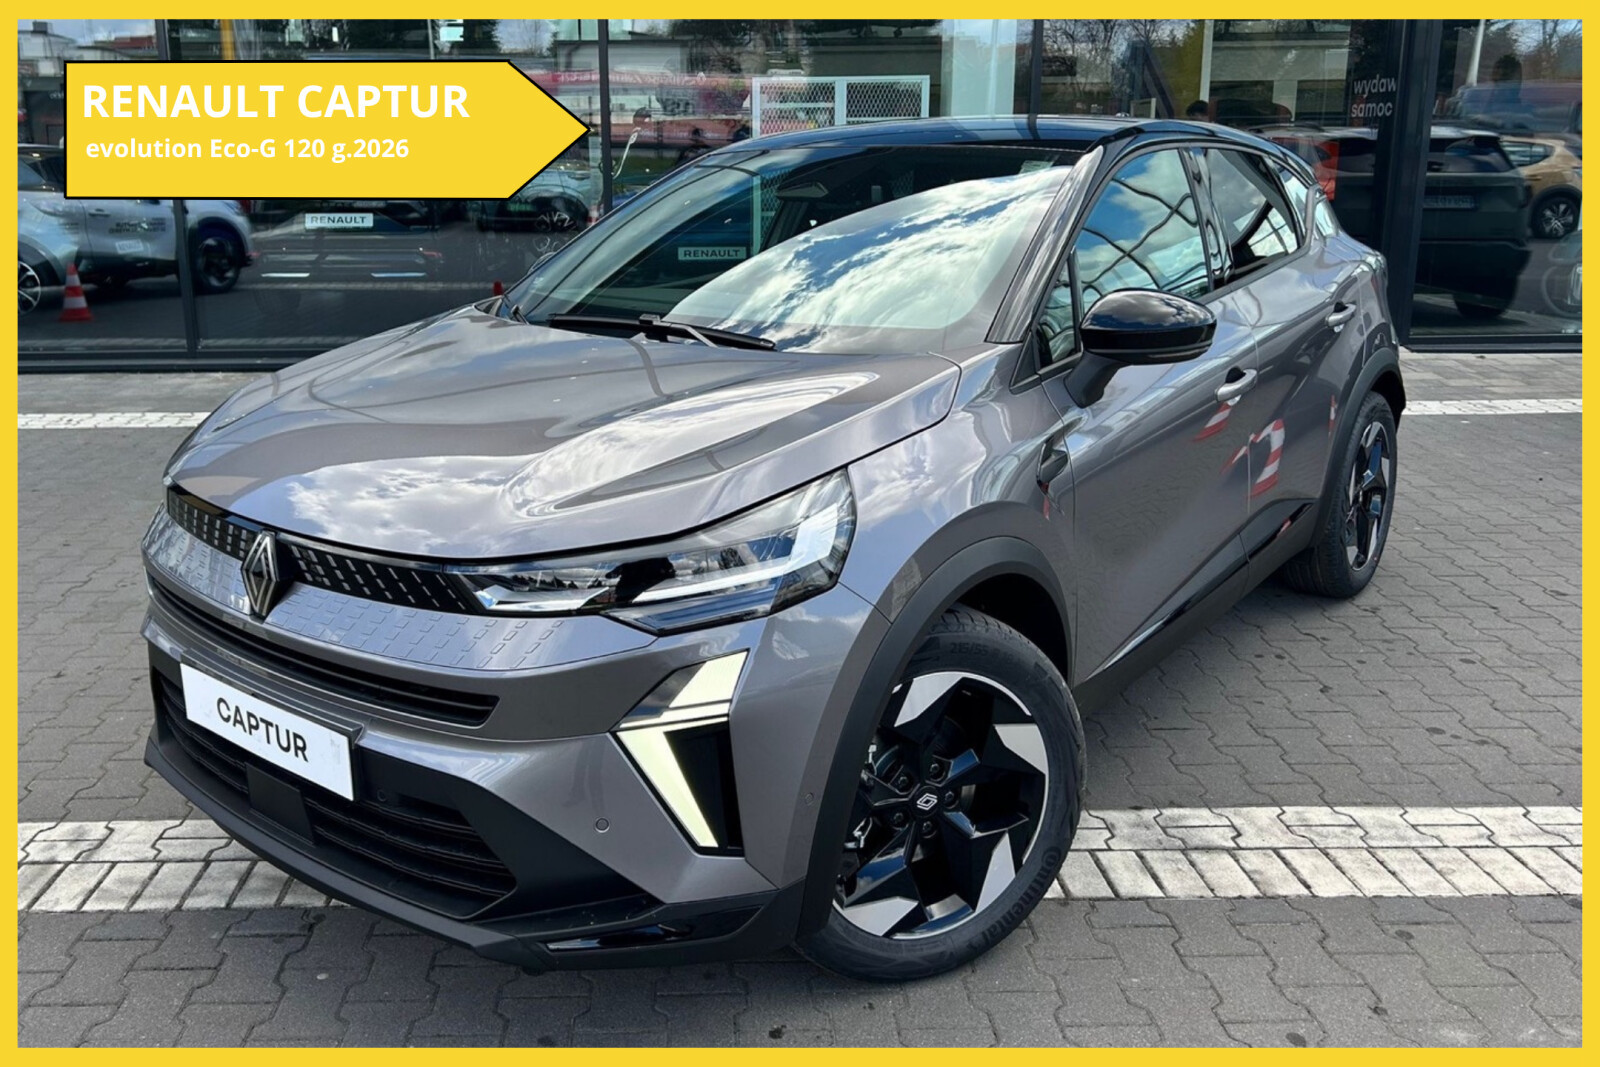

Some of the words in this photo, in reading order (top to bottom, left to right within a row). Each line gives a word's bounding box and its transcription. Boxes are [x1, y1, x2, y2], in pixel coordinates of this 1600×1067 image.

[1351, 102, 1393, 117] samoc
[310, 216, 366, 224] RENAULT
[683, 249, 740, 258] RENAULT
[217, 697, 309, 762] CAPTUR
[980, 846, 1061, 944] Continental
